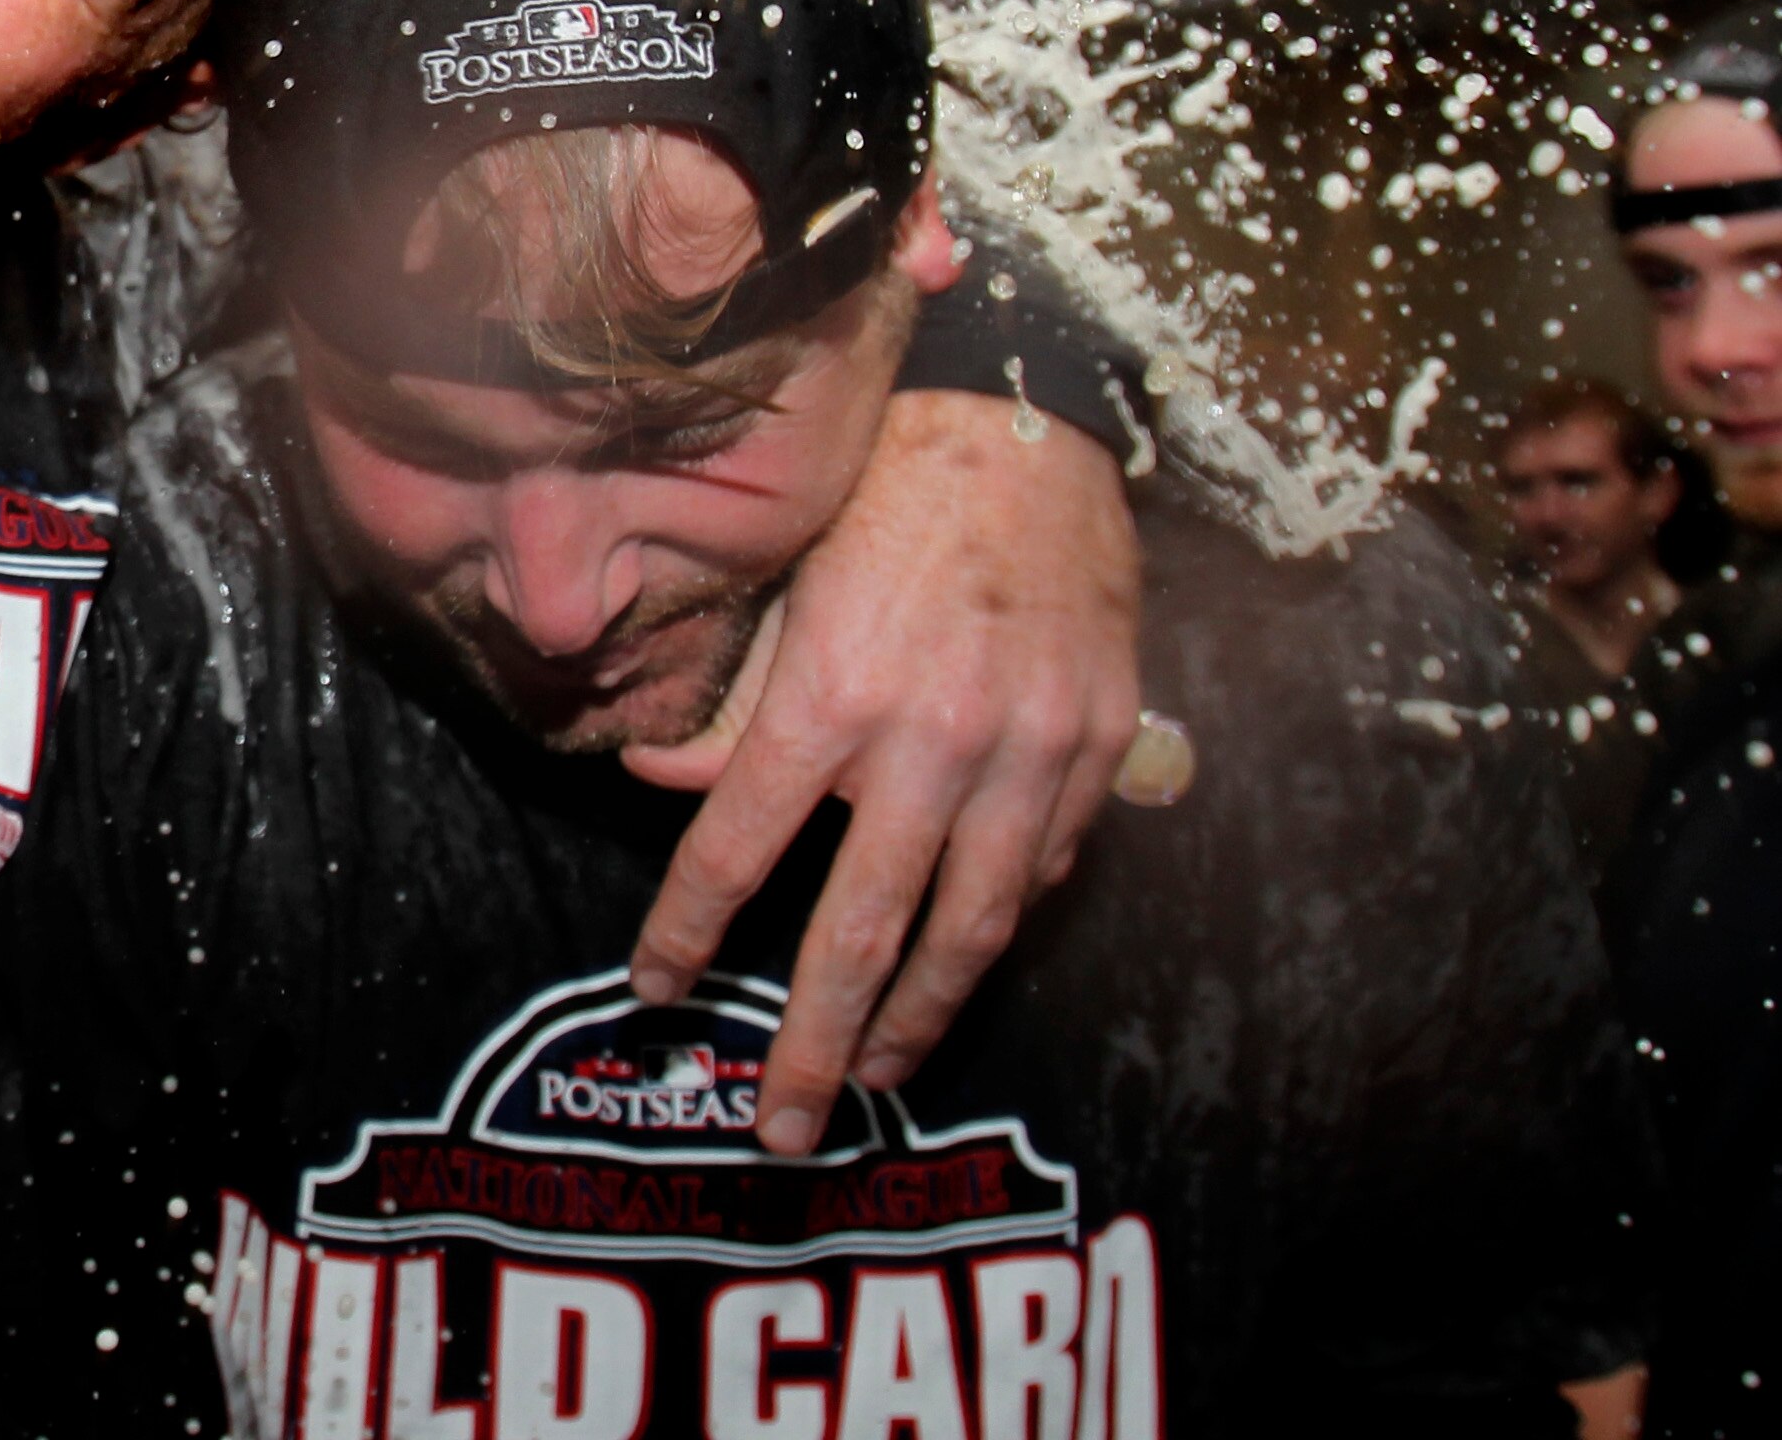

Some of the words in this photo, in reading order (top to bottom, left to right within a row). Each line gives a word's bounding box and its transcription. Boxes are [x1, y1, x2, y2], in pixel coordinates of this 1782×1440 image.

[426, 34, 708, 95] POSTSEASON
[537, 1068, 758, 1130] POSTSEAS
[375, 1145, 722, 1234] NATIONAL
[209, 1188, 652, 1440] WILD
[702, 1212, 1167, 1440] CARD
